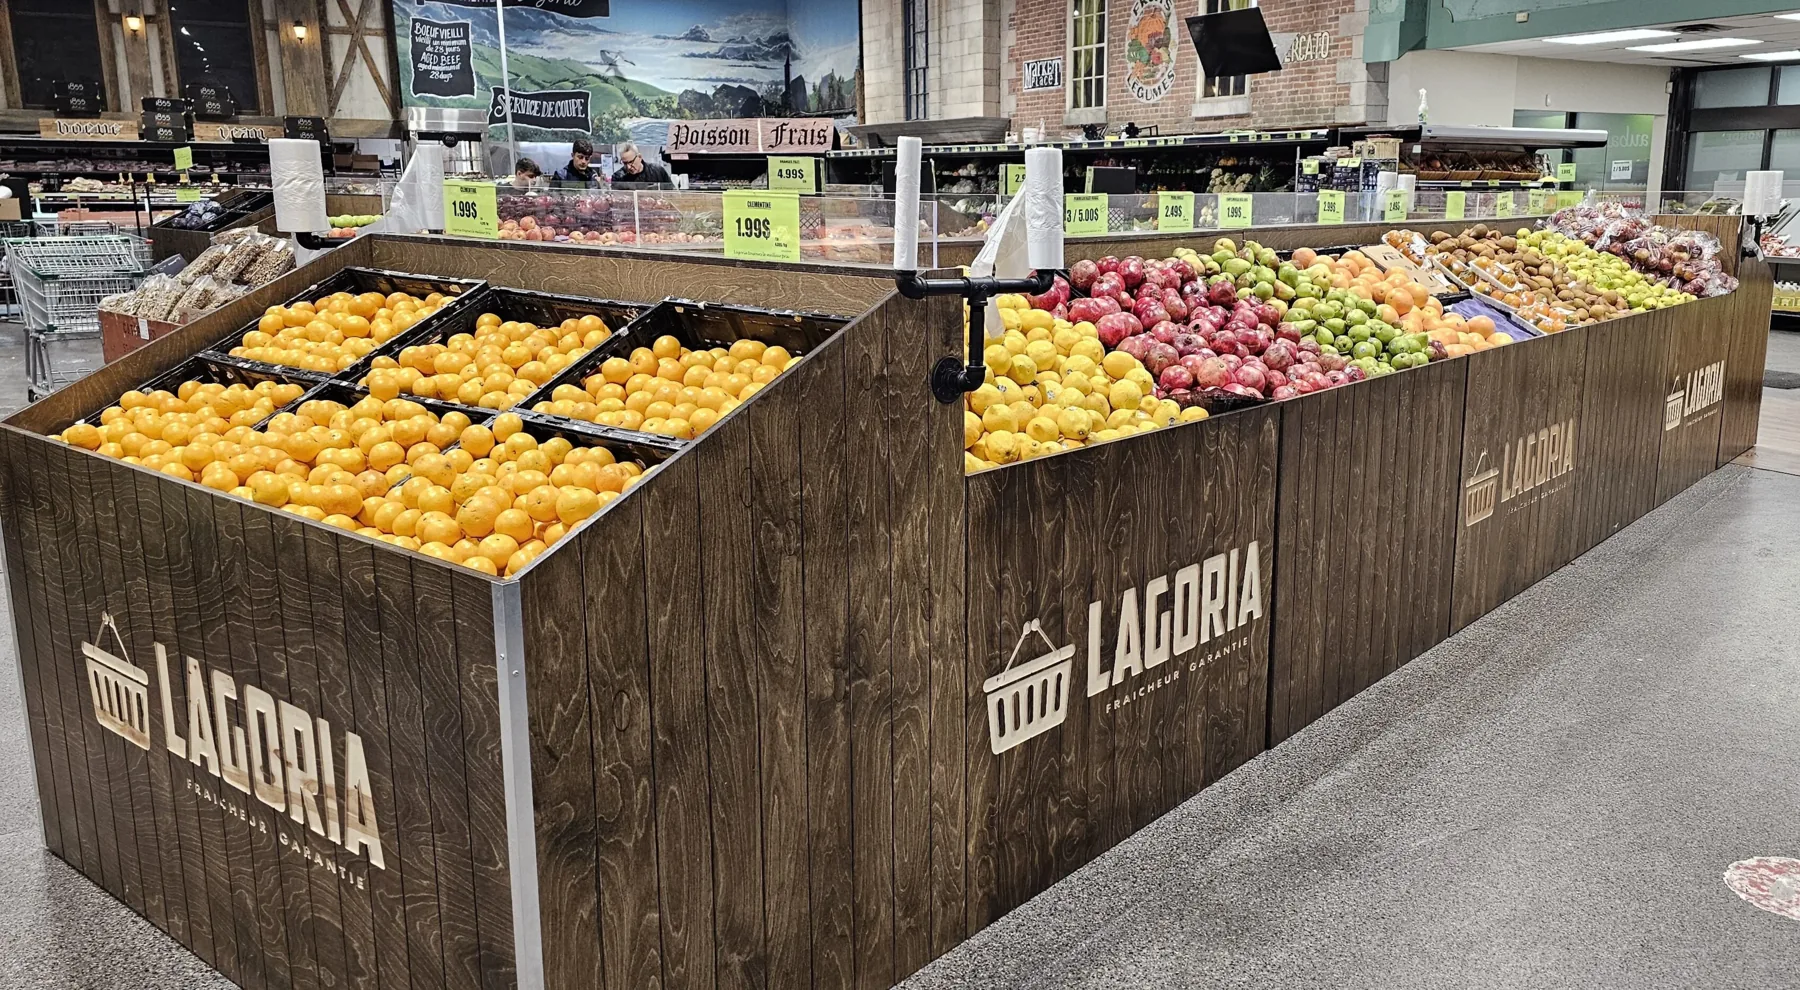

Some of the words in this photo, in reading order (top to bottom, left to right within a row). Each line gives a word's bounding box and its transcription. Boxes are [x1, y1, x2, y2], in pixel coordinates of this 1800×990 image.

[414, 22, 439, 38] BOEUF
[440, 27, 463, 39] VIEILLI
[420, 51, 439, 65] AGED
[440, 55, 461, 66] BEEF
[1284, 31, 1330, 63] RCATO
[494, 94, 541, 117] SERVICE
[541, 101, 555, 118] DE
[555, 98, 585, 118] COUPE
[671, 122, 750, 150] Poisson
[768, 121, 829, 149] Frais
[777, 168, 804, 180] 4.99$
[452, 200, 477, 220] 1.99$
[747, 201, 772, 209] CLEMENTINE
[1066, 210, 1072, 223] 3
[1078, 208, 1099, 222] 5.00$
[1165, 205, 1183, 218] 2.49$
[1227, 206, 1242, 218] 1.99$
[735, 217, 771, 240] 1.99$
[1501, 417, 1574, 503] LAGORIA
[1087, 540, 1263, 697] LAGORIA
[1105, 670, 1180, 714] FRAICHEUR
[1189, 636, 1249, 672] GARANTIE
[154, 641, 385, 870] LAGORIA
[186, 778, 267, 834] FRAICHEUR
[279, 833, 365, 889] GARANTIE
